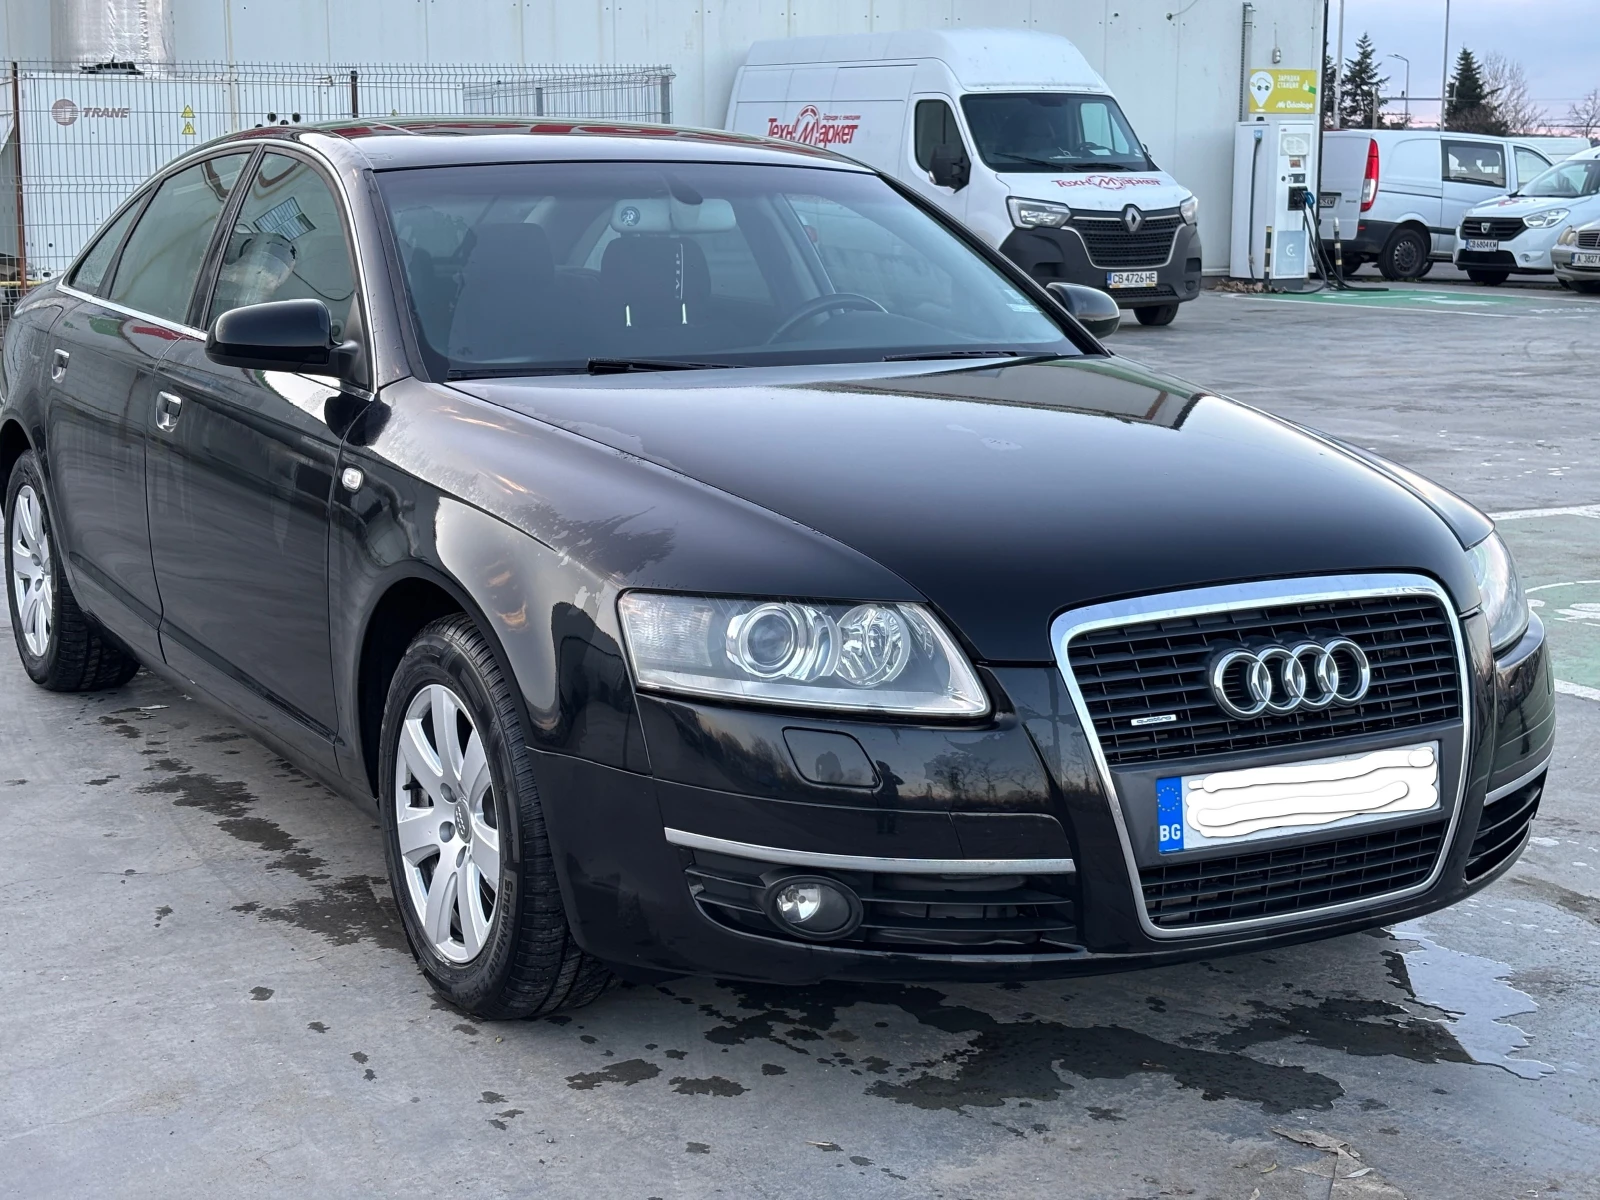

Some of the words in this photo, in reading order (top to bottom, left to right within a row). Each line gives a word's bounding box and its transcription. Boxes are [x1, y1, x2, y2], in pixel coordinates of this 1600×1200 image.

[83, 107, 130, 118] TRANE
[1125, 272, 1144, 284] 4726
[1159, 823, 1181, 842] BG
